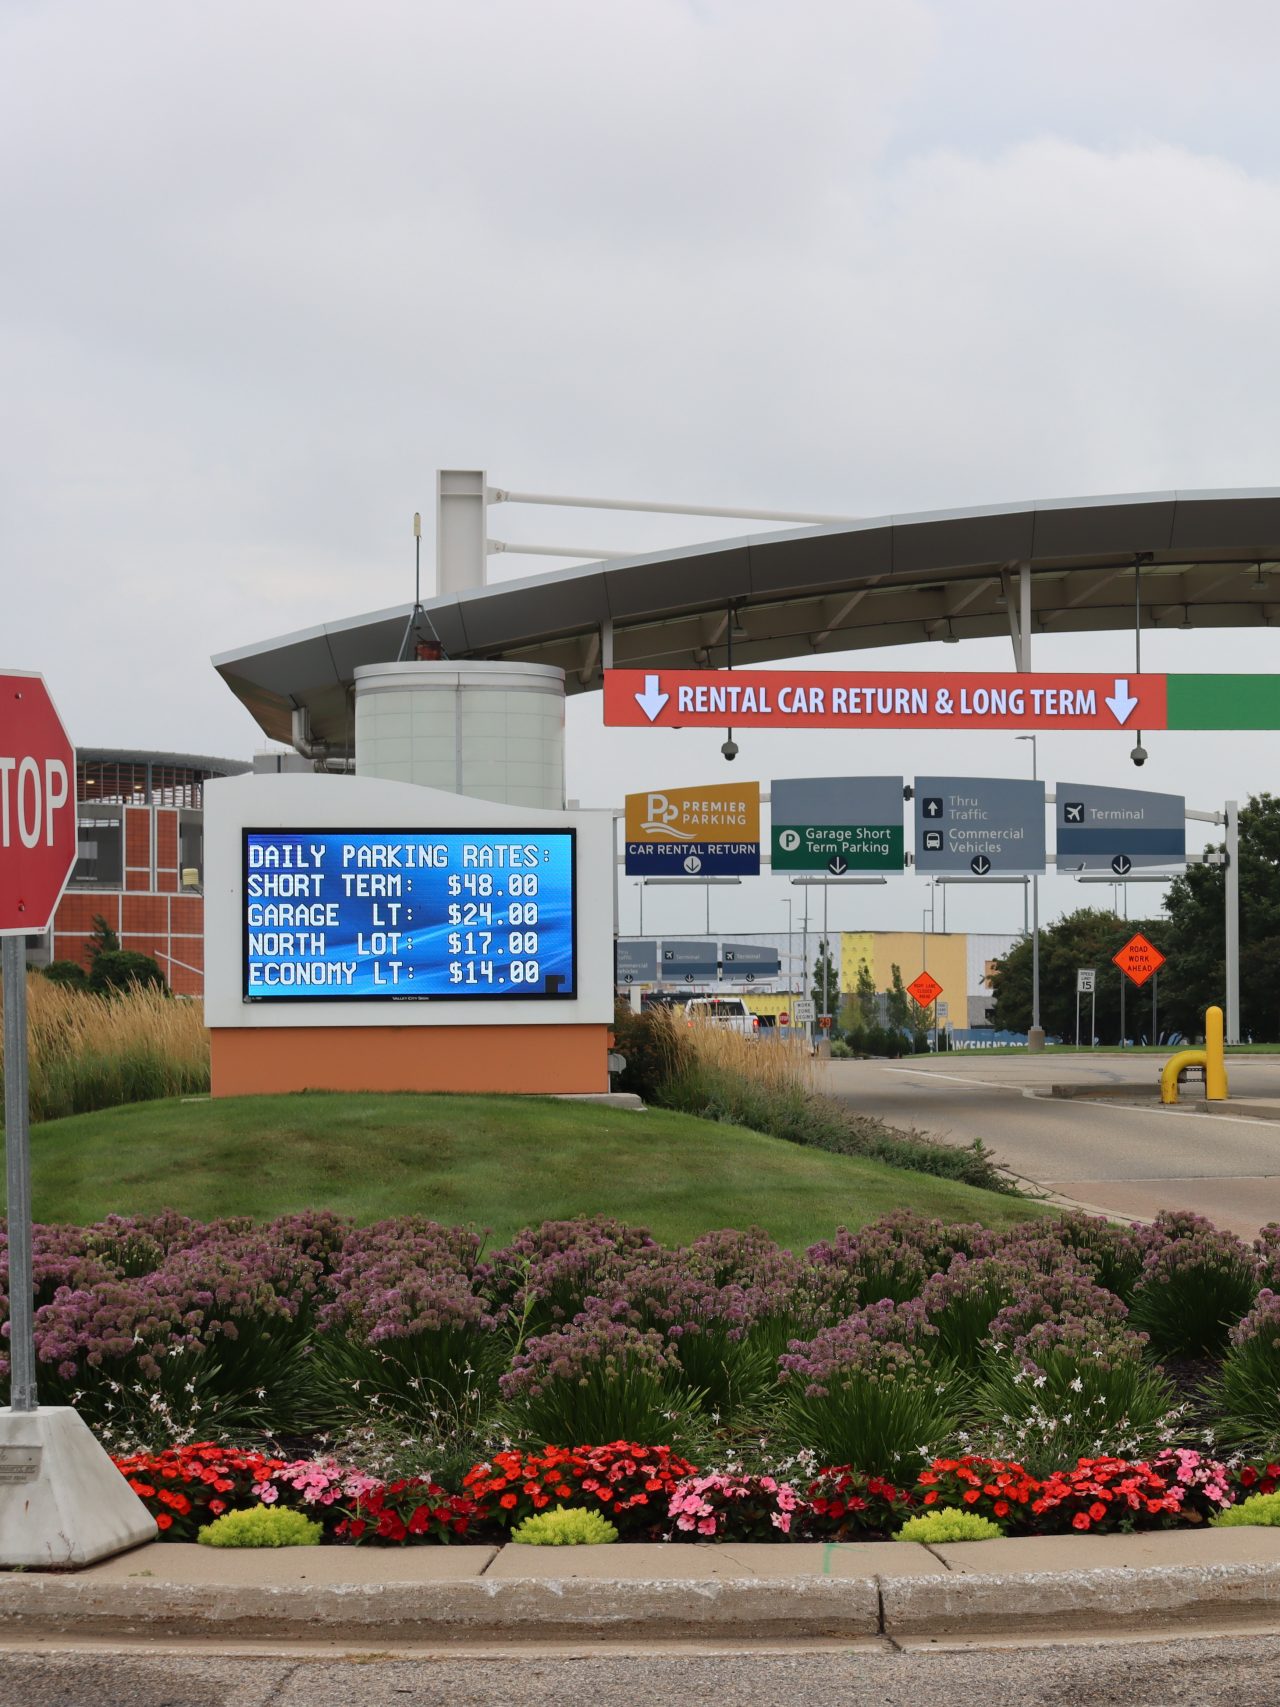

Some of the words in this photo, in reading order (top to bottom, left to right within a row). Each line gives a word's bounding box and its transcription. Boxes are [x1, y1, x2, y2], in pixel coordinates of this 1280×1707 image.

[678, 686, 772, 714] RENTAL
[777, 687, 825, 714] CAR
[832, 687, 928, 715] RETURN
[934, 688, 954, 714] &
[960, 688, 1025, 715] LONG
[1030, 690, 1096, 716] TERM
[0, 756, 68, 848] TOP
[682, 801, 746, 812] PREMIER
[949, 795, 978, 806] Thru
[682, 814, 746, 825] PARKING
[949, 808, 988, 820] Traffic
[1091, 808, 1144, 820] Terminal
[805, 828, 853, 842] Garage
[856, 828, 891, 839] Short
[949, 828, 1024, 840] Commercial
[629, 844, 654, 855] CAR
[657, 844, 704, 855] RENTAL
[708, 844, 756, 855] RETURN
[806, 842, 838, 853] Term
[842, 841, 890, 856] Parking
[949, 841, 1002, 853] Vehicles
[249, 844, 326, 868] DAILY
[342, 844, 449, 868] PARKING
[462, 844, 550, 868] RATES:
[247, 874, 325, 897] SHORT
[341, 873, 413, 897] TERM:
[447, 873, 539, 897] $48.00
[247, 903, 340, 927] GARAGE
[373, 903, 413, 926] LT:
[447, 903, 539, 926] $24.00
[247, 932, 326, 956] NORTH
[357, 932, 414, 956] LOT:
[447, 931, 539, 955] $17.00
[1129, 945, 1148, 953] ROAD
[1128, 955, 1150, 963] WORK
[249, 962, 357, 985] ECONOMY
[374, 961, 414, 985] LT:
[449, 960, 540, 984] $14.00
[1127, 964, 1153, 972] AHEAD
[1082, 981, 1092, 990] 15
[819, 1017, 831, 1028] 29
